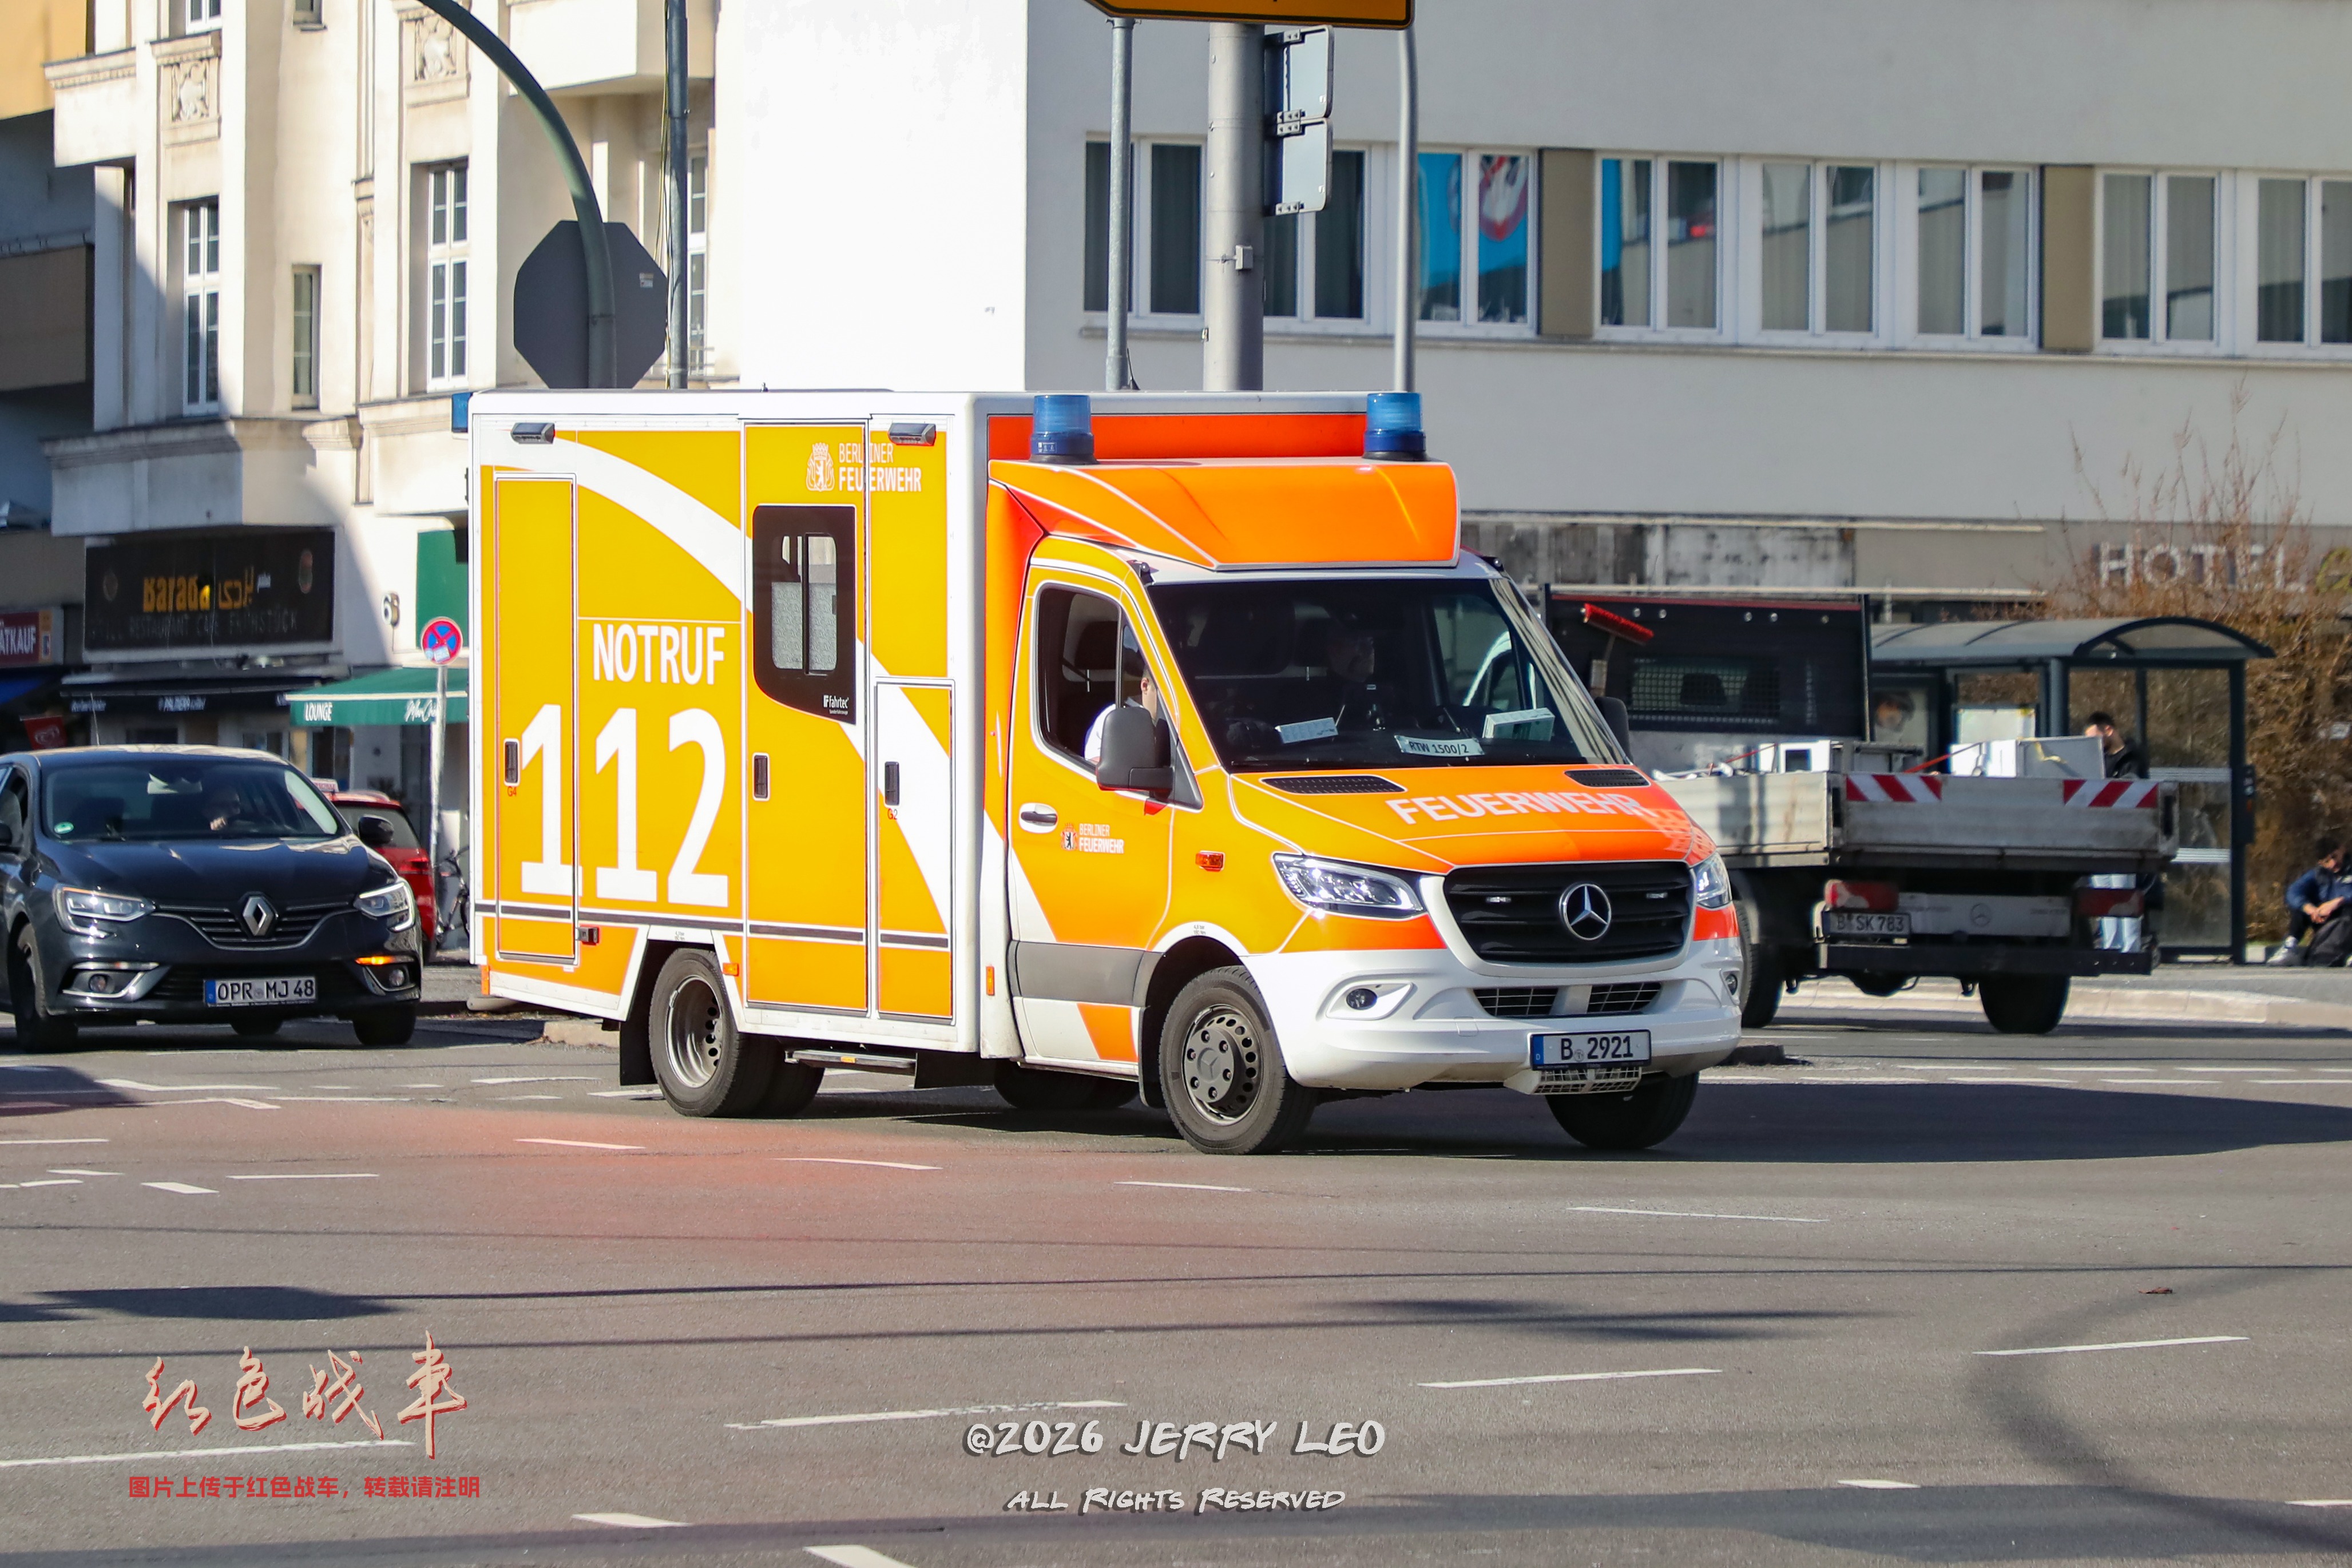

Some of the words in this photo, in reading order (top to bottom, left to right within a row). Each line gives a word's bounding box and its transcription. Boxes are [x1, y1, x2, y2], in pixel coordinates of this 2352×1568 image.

[838, 442, 894, 464] BERLINER
[838, 466, 922, 493] FEUERWEHR
[2093, 540, 2308, 594] HOTEL
[593, 623, 725, 685] NOTRUF
[305, 701, 333, 721] LOUNGE
[1409, 740, 1431, 754] RTW
[1431, 743, 1470, 755] 1500/2
[507, 786, 517, 797] G4
[521, 703, 728, 907] 112
[887, 808, 898, 820] G2
[1385, 791, 1659, 825] FEUERWEHR
[1079, 823, 1110, 837] BERLINER
[1079, 837, 1124, 854] FEUERWEHR
[1837, 914, 1846, 930] B
[1856, 915, 1875, 931] SK
[1877, 916, 1905, 932] 783
[217, 982, 253, 1001] OPR
[265, 981, 289, 999] MJ
[293, 979, 314, 997] 48
[1560, 1037, 1574, 1061] B
[1587, 1035, 1634, 1059] 2921
